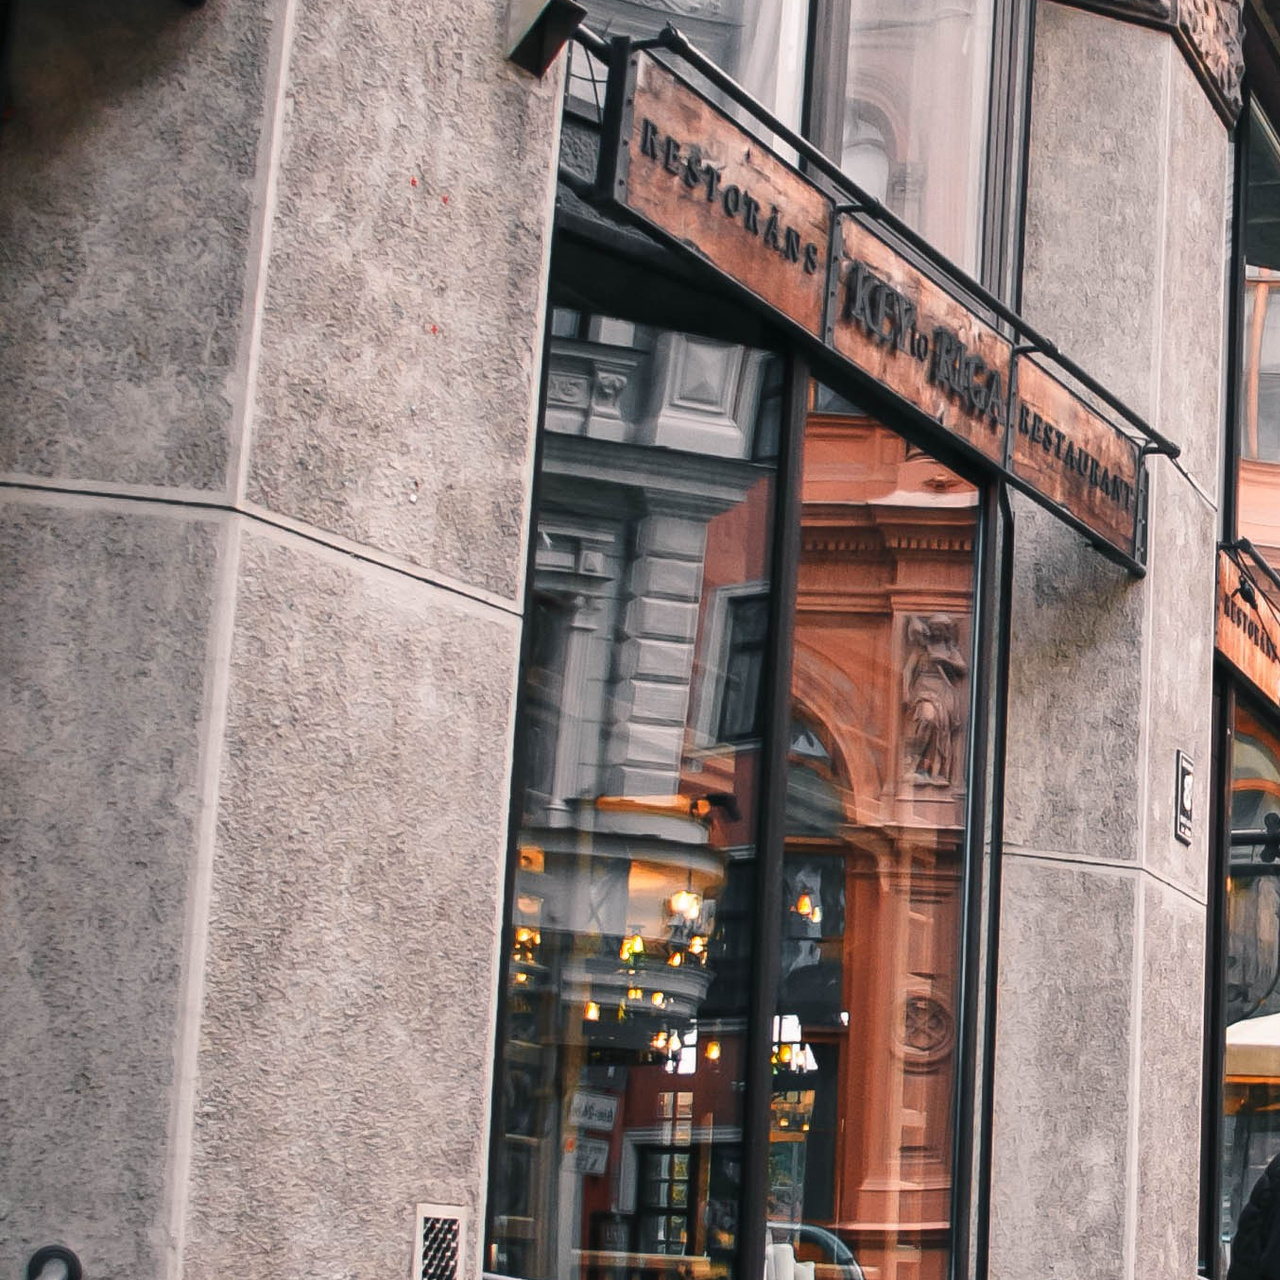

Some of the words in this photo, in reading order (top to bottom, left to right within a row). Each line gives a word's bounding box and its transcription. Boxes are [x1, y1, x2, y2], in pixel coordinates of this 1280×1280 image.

[846, 260, 917, 357] KEY
[909, 324, 929, 363] to
[930, 325, 1005, 431] RIGA
[1018, 401, 1134, 511] RESTAURANT
